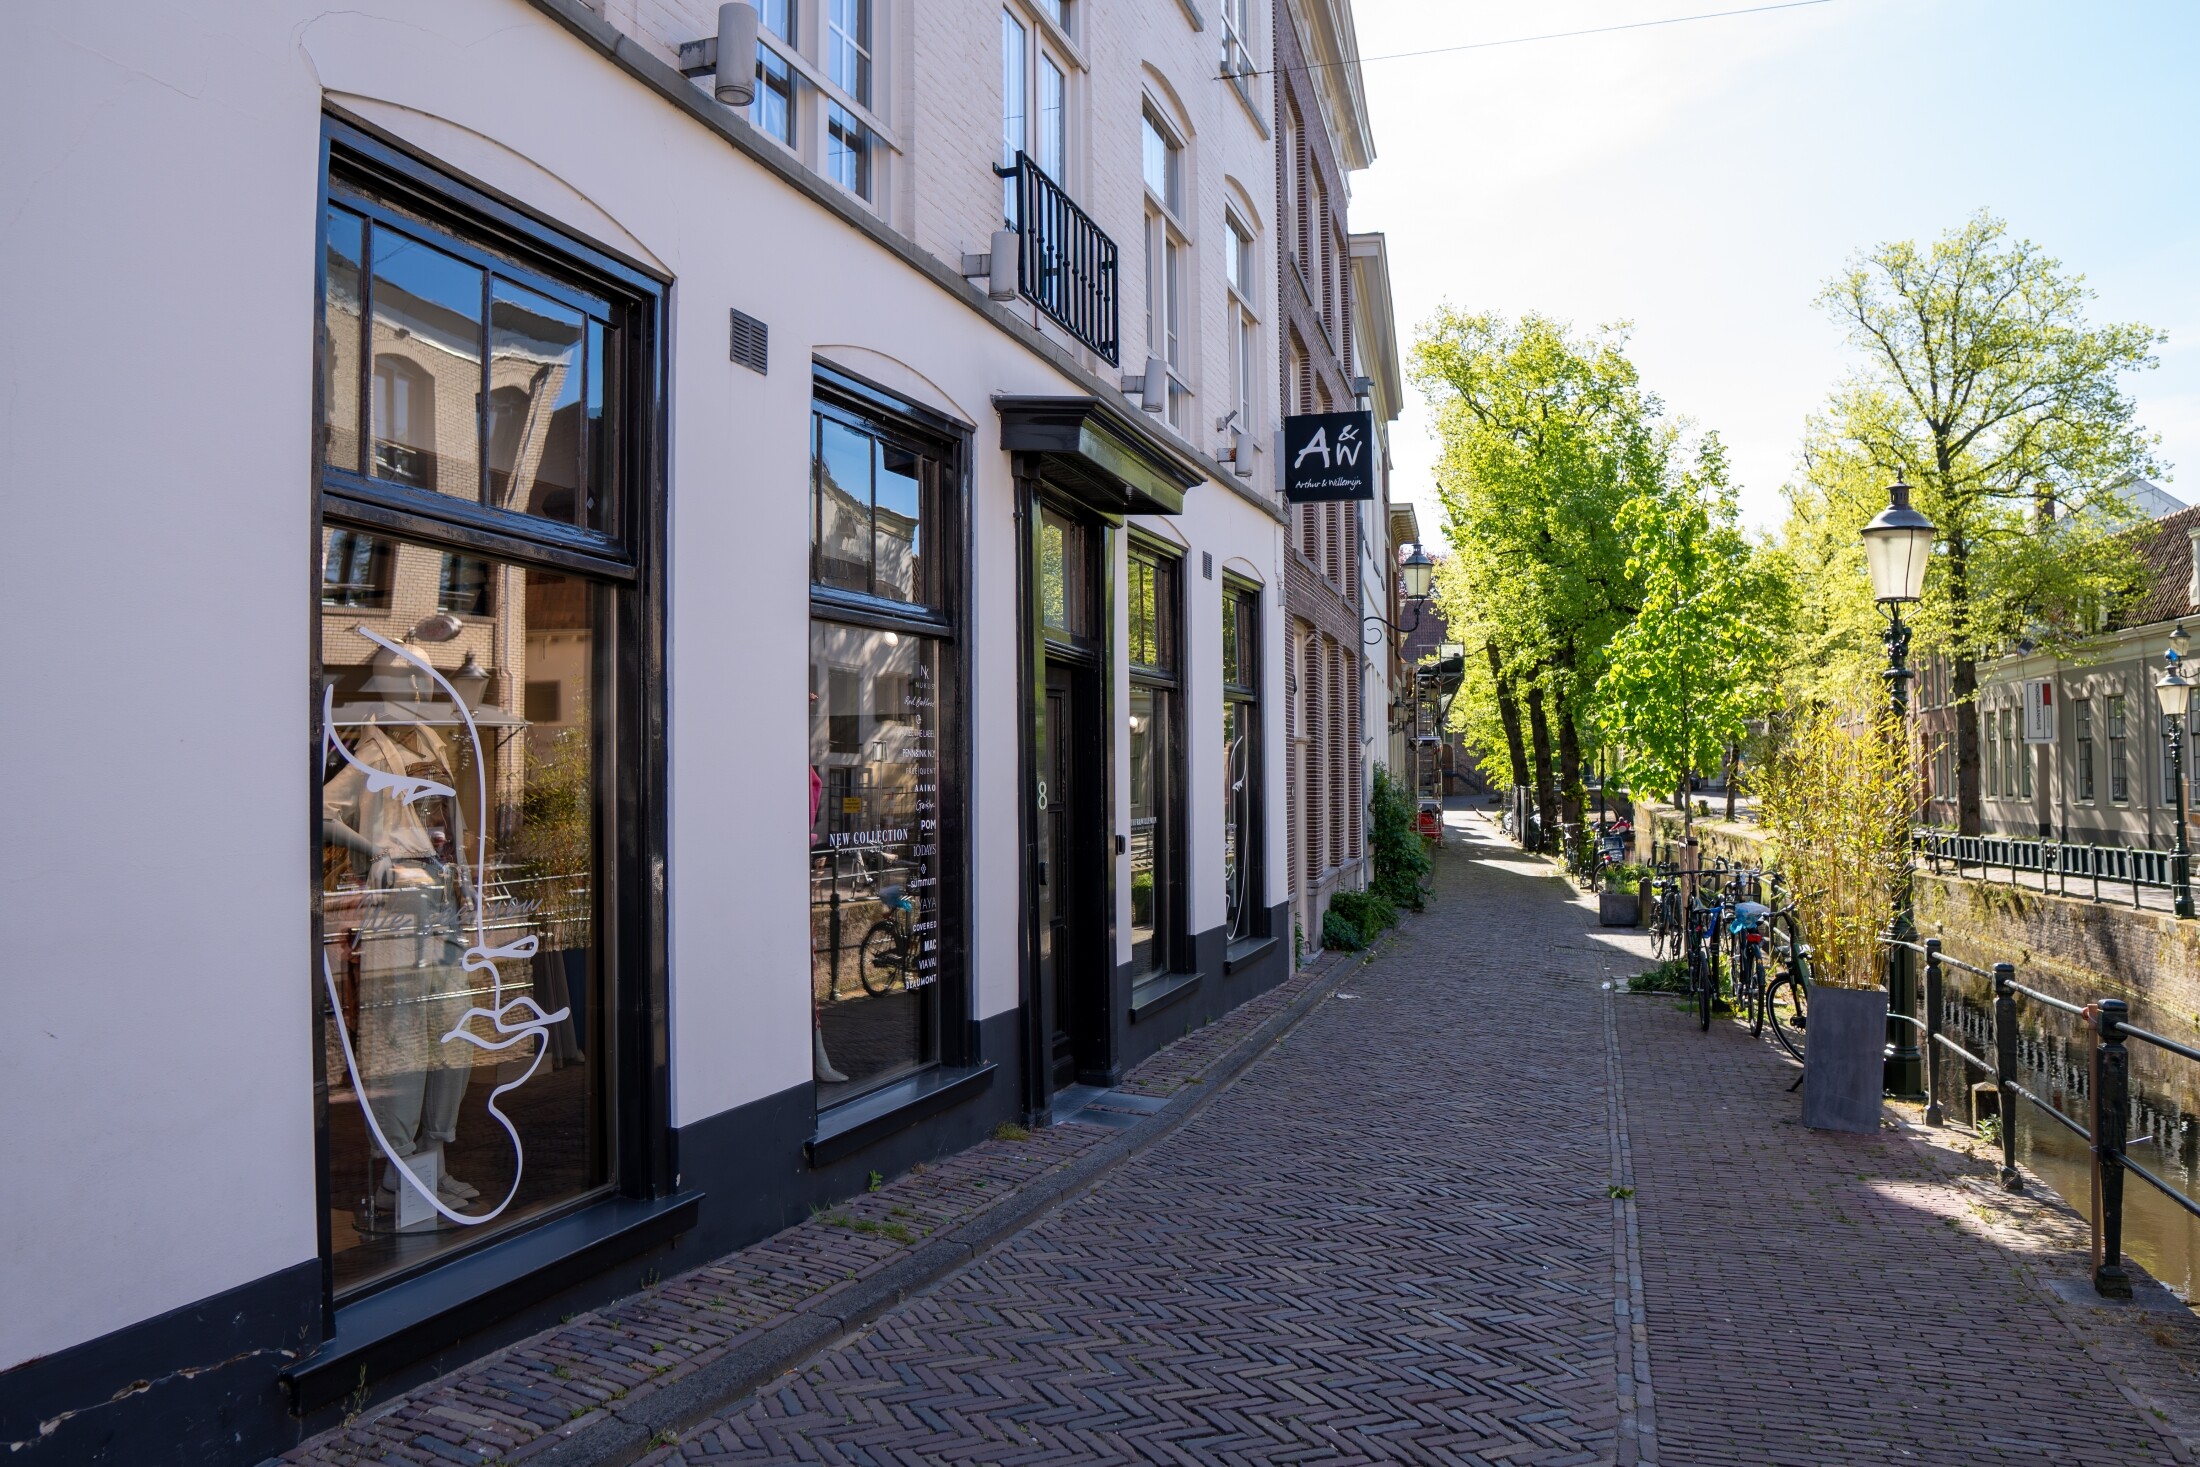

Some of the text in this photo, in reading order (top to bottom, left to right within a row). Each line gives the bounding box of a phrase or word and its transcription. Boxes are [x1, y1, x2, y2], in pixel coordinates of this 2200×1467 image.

[1295, 475, 1363, 491] Arthur & Willemijn
[914, 784, 936, 793] AAIKO
[1038, 781, 1048, 811] 8
[920, 819, 937, 831] POM
[829, 828, 909, 847] NEW COLLECTION
[485, 896, 544, 937] you
[912, 920, 938, 932] COVERED
[924, 939, 937, 952] MAC
[906, 973, 937, 990] BEAUMONT
